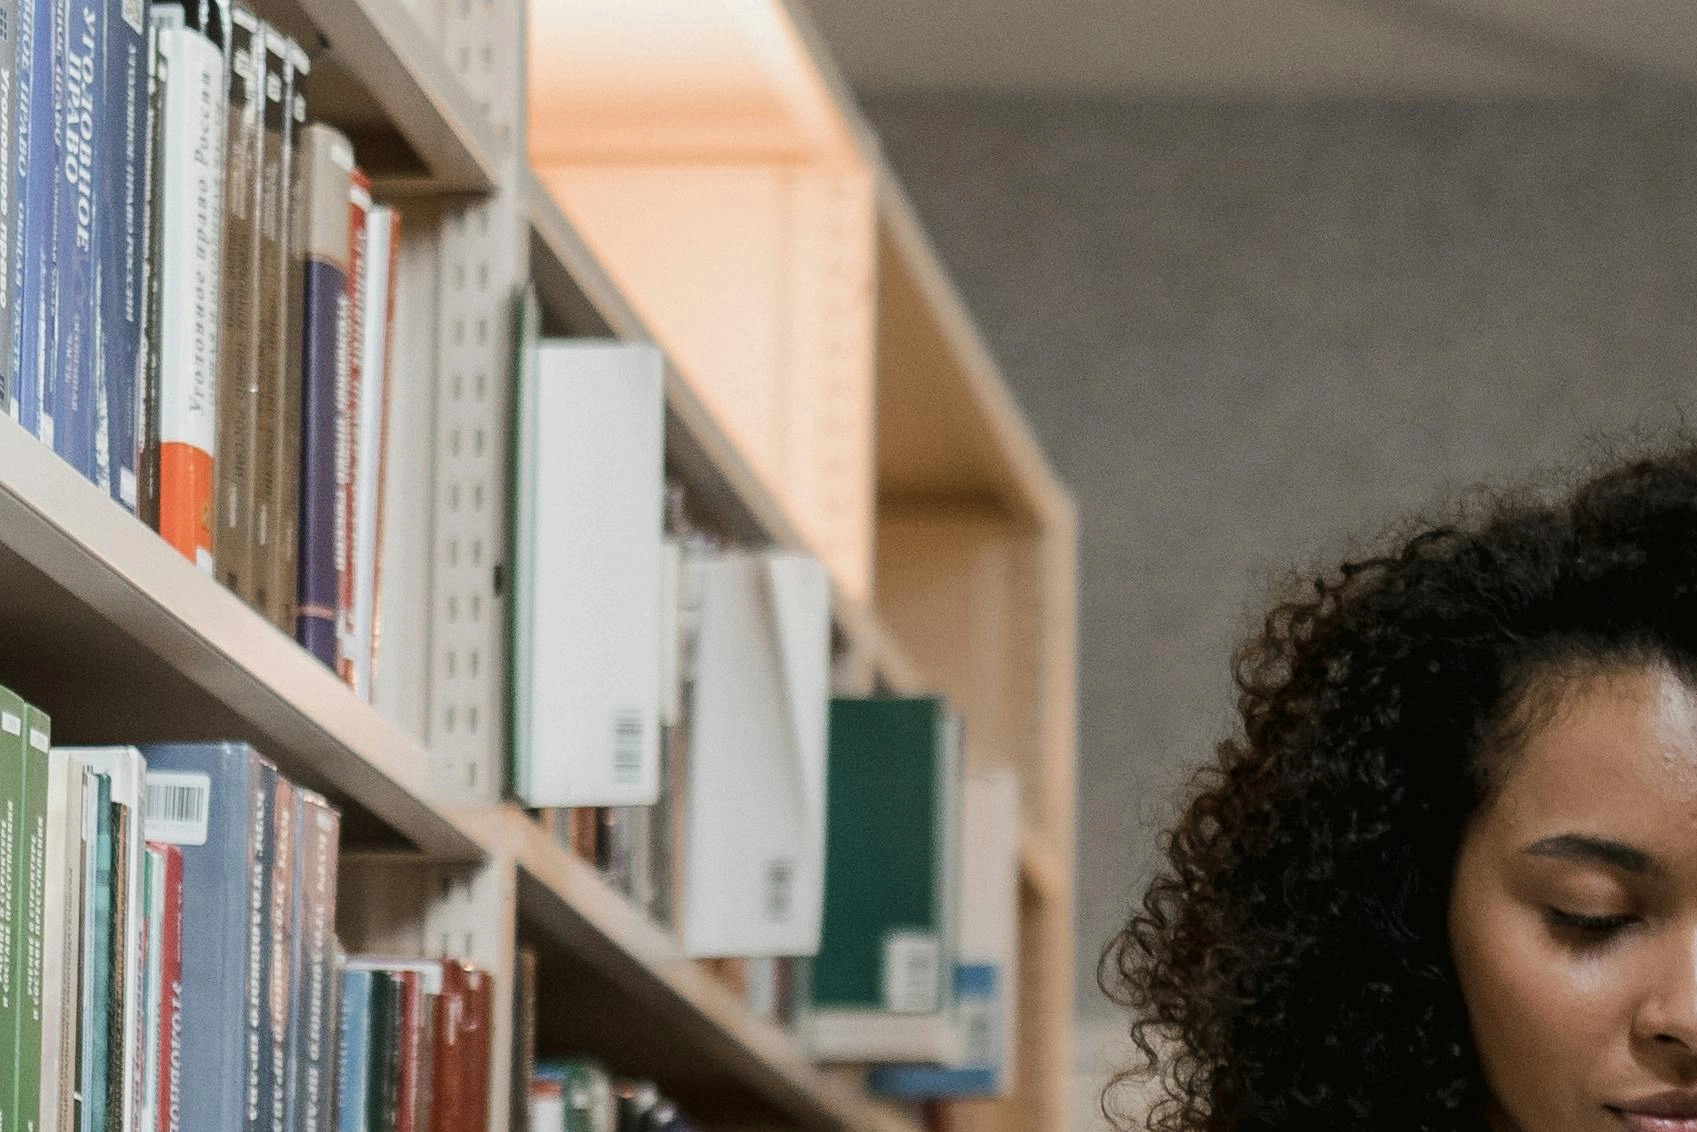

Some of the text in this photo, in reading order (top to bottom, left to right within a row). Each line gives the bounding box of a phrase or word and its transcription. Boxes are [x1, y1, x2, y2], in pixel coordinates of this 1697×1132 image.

[18, 80, 29, 178] ПРАВО
[64, 52, 82, 185] ПРАВО
[75, 6, 97, 252] УГОЛОВНОЕ
[189, 69, 211, 416] Уголовное право России
